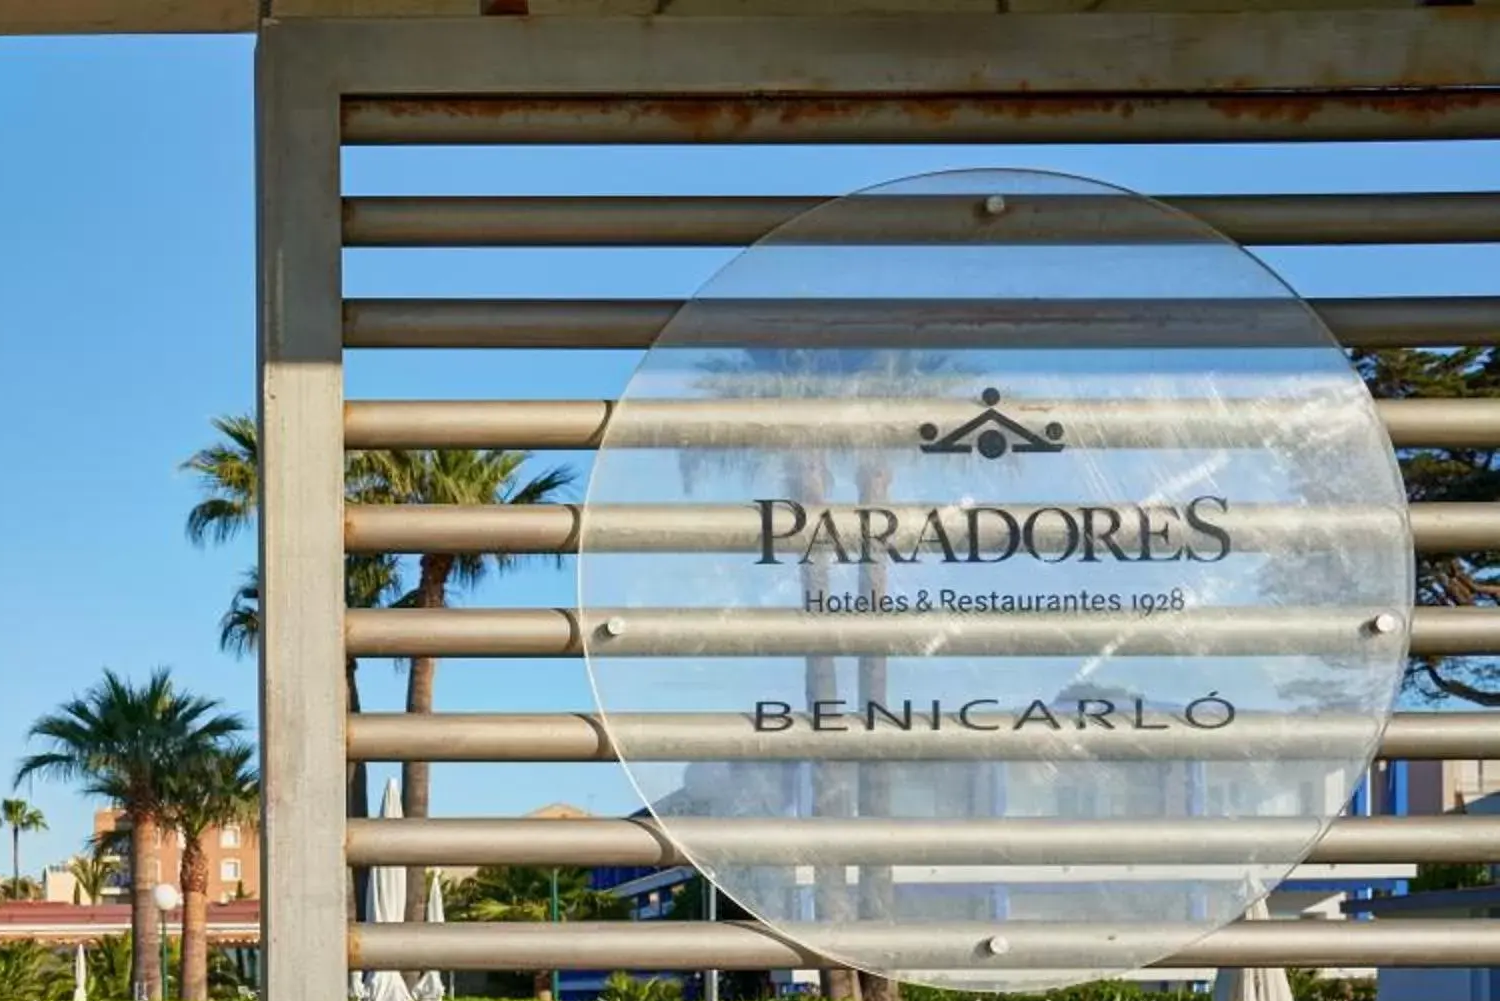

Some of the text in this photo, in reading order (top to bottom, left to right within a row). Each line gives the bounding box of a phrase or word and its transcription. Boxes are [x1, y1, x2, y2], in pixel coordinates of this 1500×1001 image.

[753, 495, 1231, 564] PARADORES
[804, 587, 1185, 617] Hoteles & Restaurantes 1928
[754, 691, 1236, 732] BENICARLÓ
